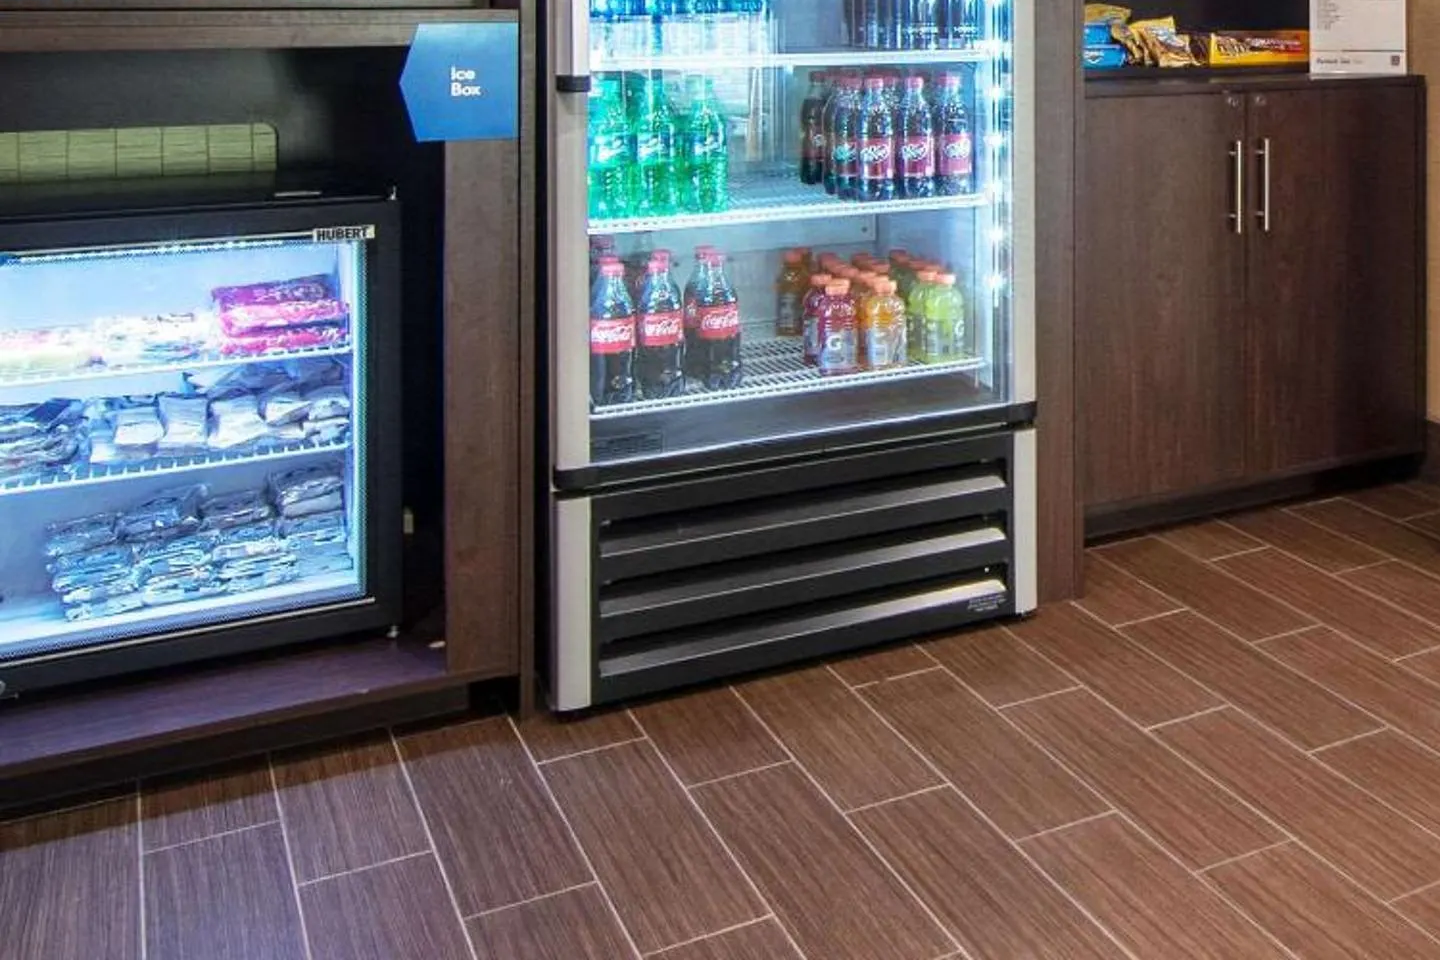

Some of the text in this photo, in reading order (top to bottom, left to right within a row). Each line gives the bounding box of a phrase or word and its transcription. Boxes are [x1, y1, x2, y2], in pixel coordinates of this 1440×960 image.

[451, 64, 476, 81] Ice
[451, 82, 482, 97] Box
[316, 225, 369, 241] HUBERT
[826, 335, 843, 351] G
